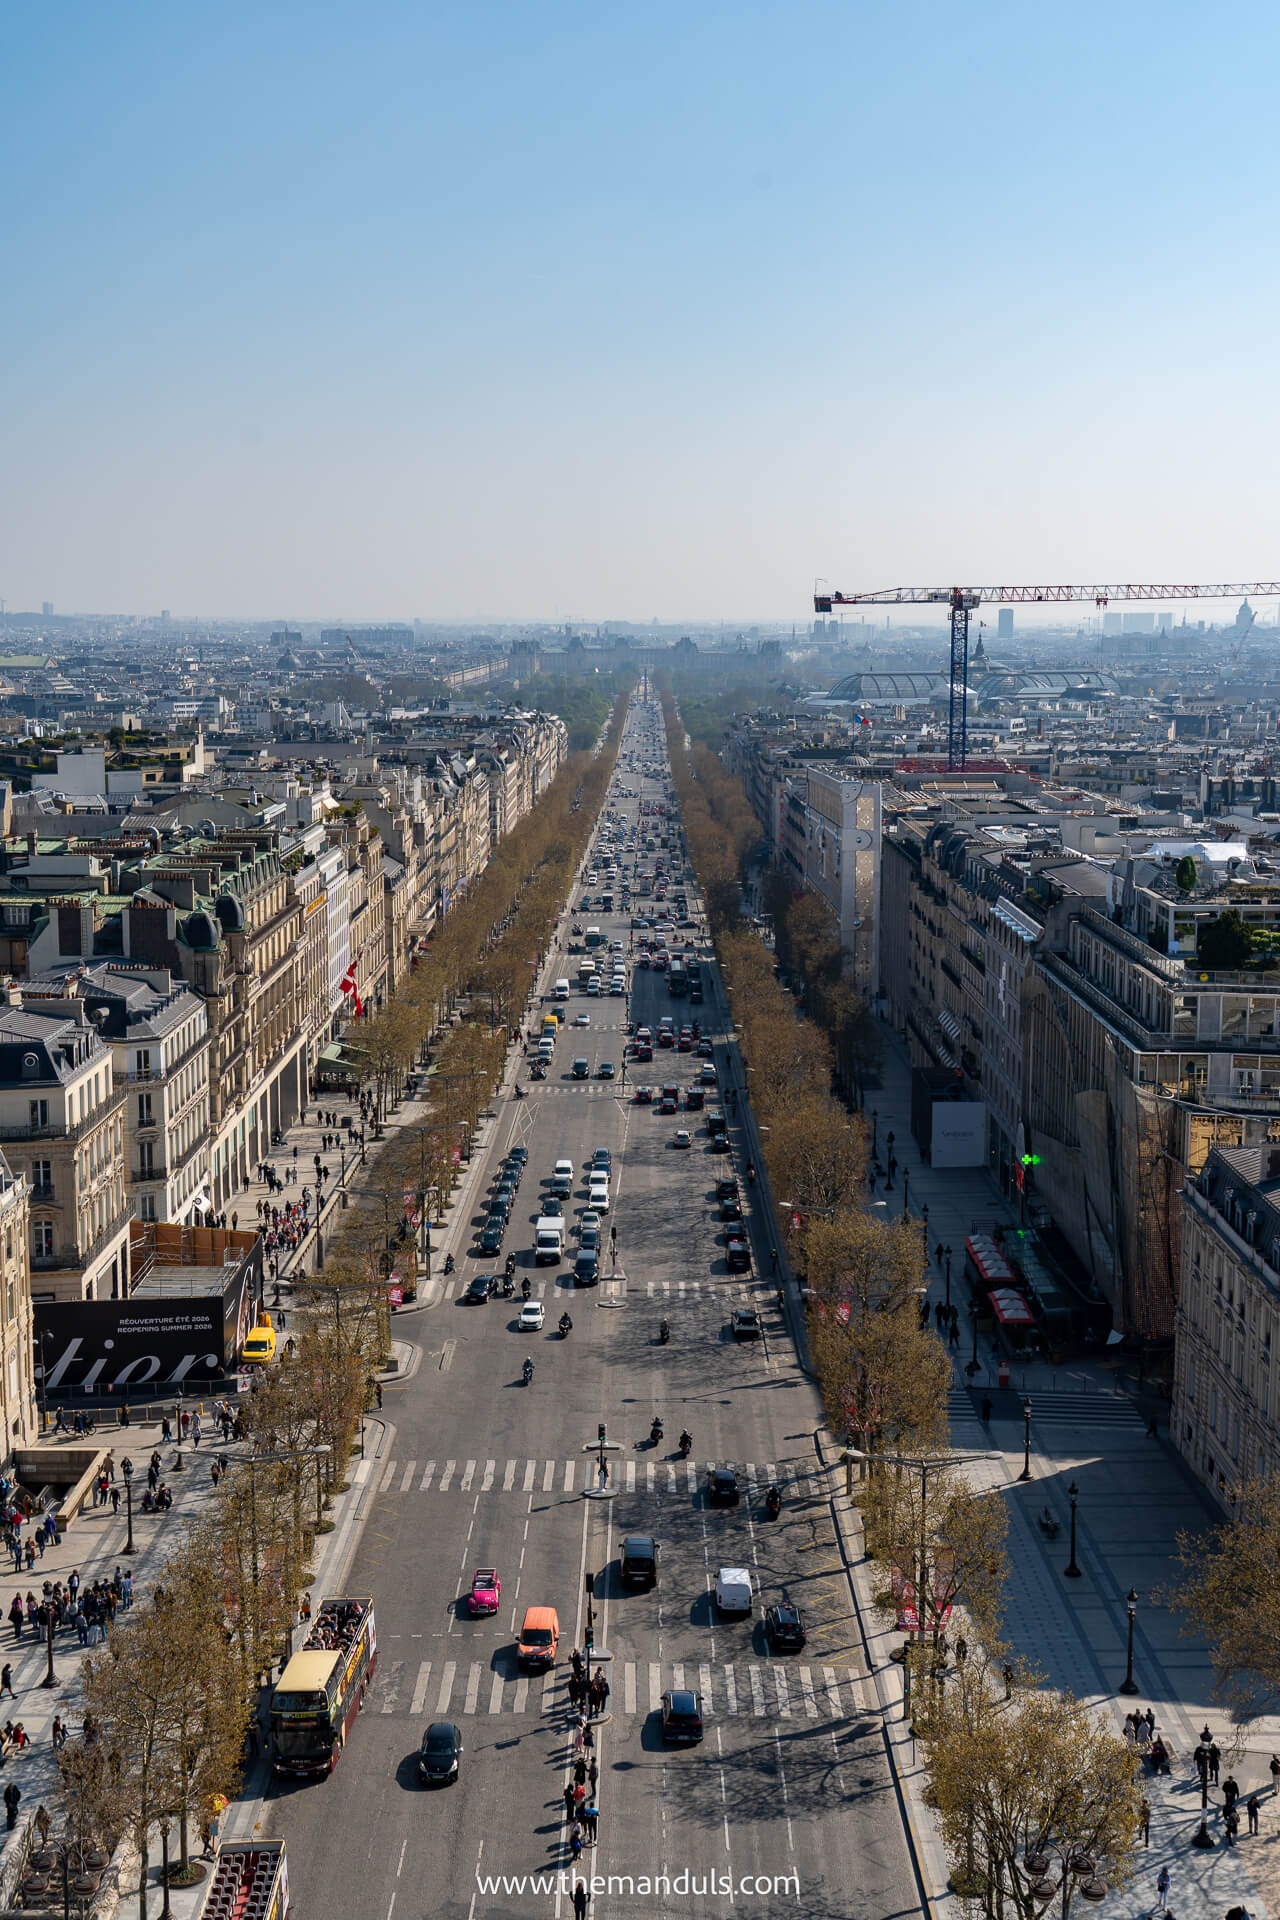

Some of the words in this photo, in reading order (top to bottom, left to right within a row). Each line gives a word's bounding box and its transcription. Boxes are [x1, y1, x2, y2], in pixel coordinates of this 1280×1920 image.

[119, 1317, 174, 1325] RÉOUVERTURE
[175, 1315, 190, 1323] ÉTÉ
[117, 1325, 160, 1333] REOPENING
